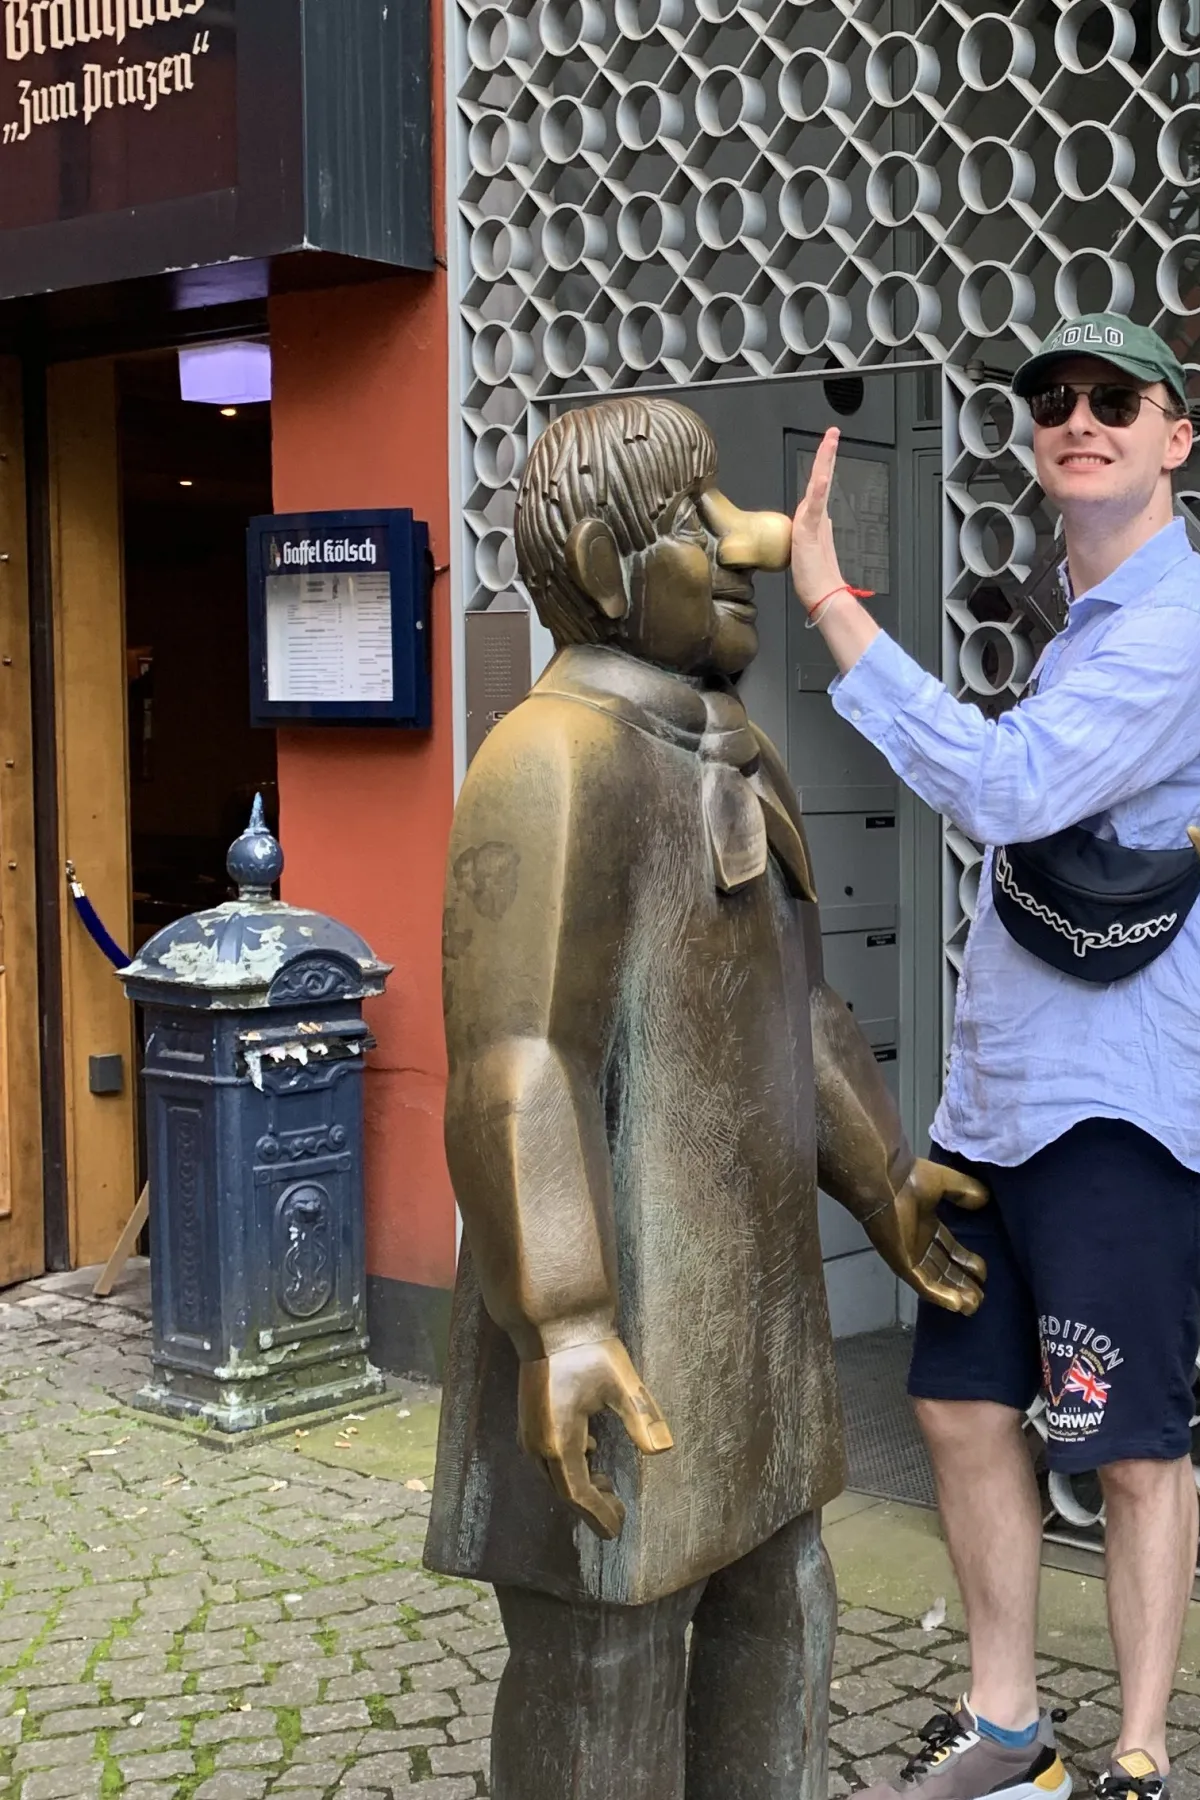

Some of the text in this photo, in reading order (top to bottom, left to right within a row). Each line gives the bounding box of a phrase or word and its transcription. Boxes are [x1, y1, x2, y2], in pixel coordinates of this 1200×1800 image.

[283, 537, 377, 566] Gaffel Kölsch
[1046, 1339, 1074, 1358] 1953
